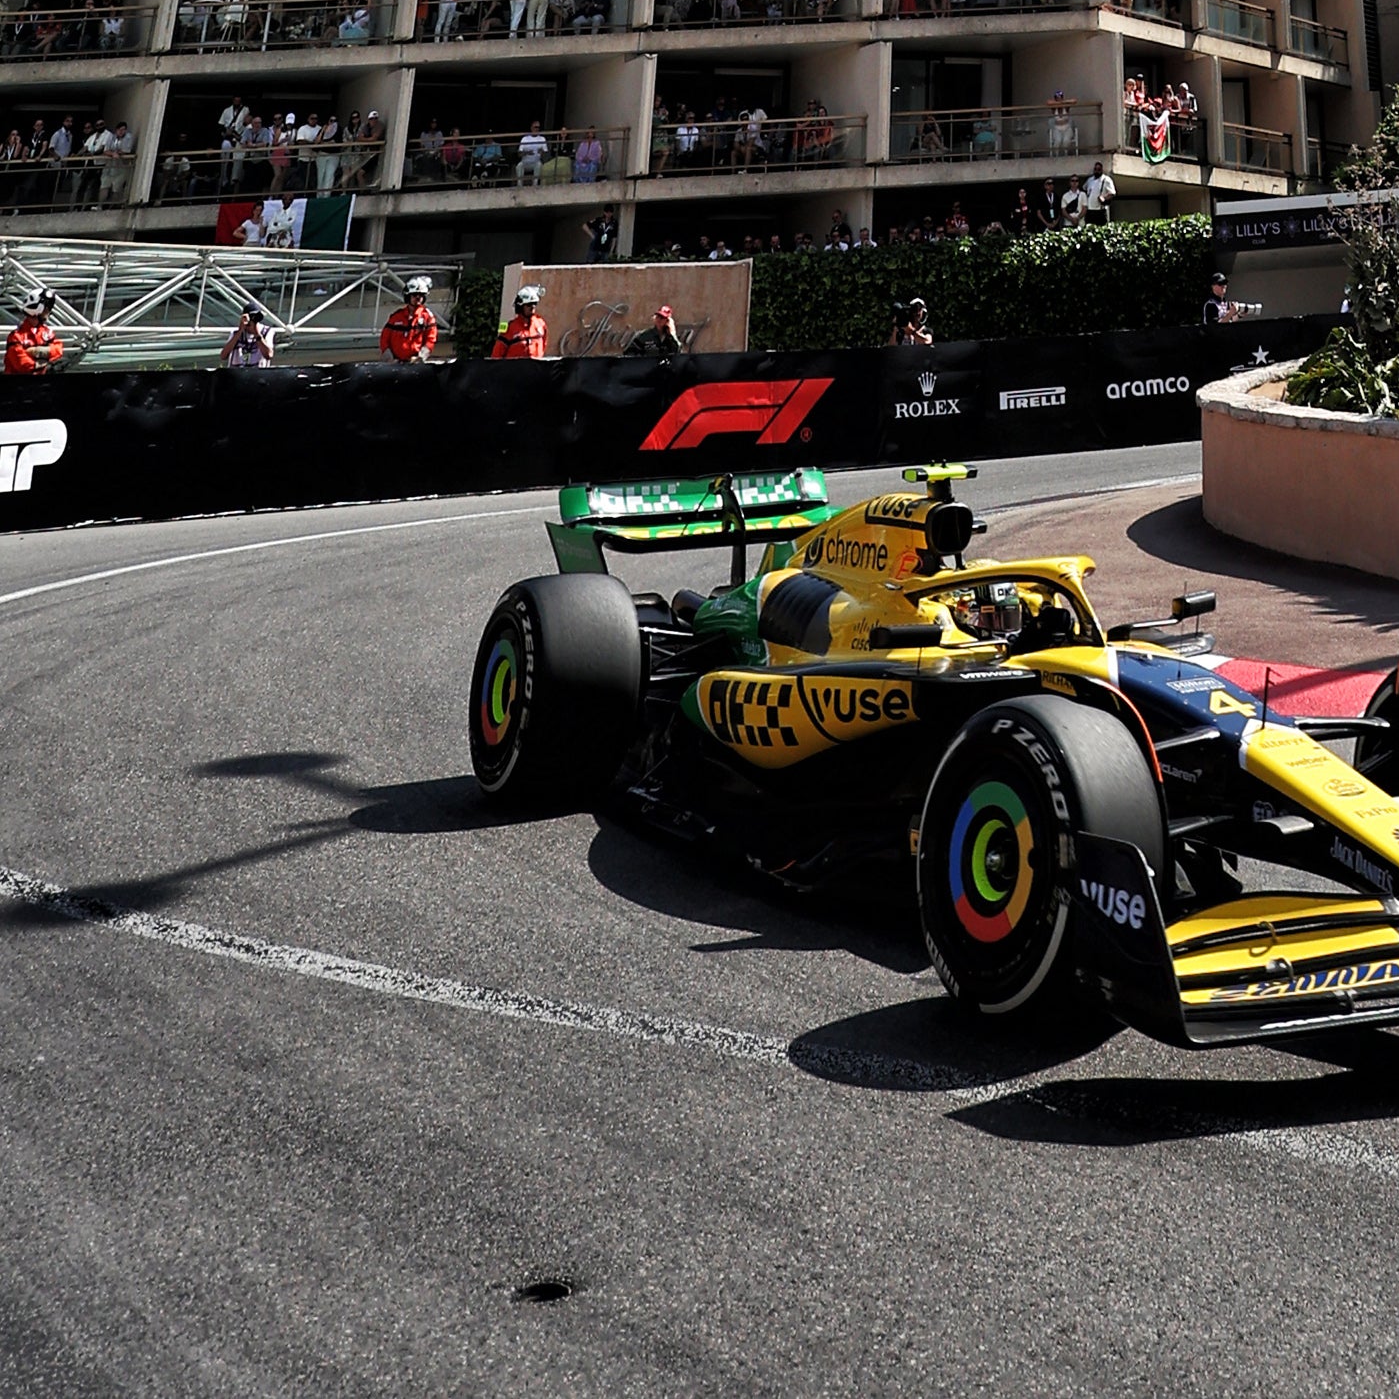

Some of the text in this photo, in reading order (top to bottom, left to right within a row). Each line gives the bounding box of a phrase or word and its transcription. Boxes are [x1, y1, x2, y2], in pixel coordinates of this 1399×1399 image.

[1236, 221, 1281, 237] LILLY'S
[1000, 386, 1066, 410] PIRELLI
[1106, 376, 1189, 399] aramco
[638, 378, 835, 450] F1
[894, 398, 961, 419] ROLEX
[826, 529, 888, 571] chrome
[521, 616, 535, 700] ZERO
[851, 637, 873, 651] CISC
[811, 688, 909, 723] vuse
[1209, 689, 1257, 718] 4
[991, 719, 1013, 734] P
[1013, 729, 1069, 821] ZERO
